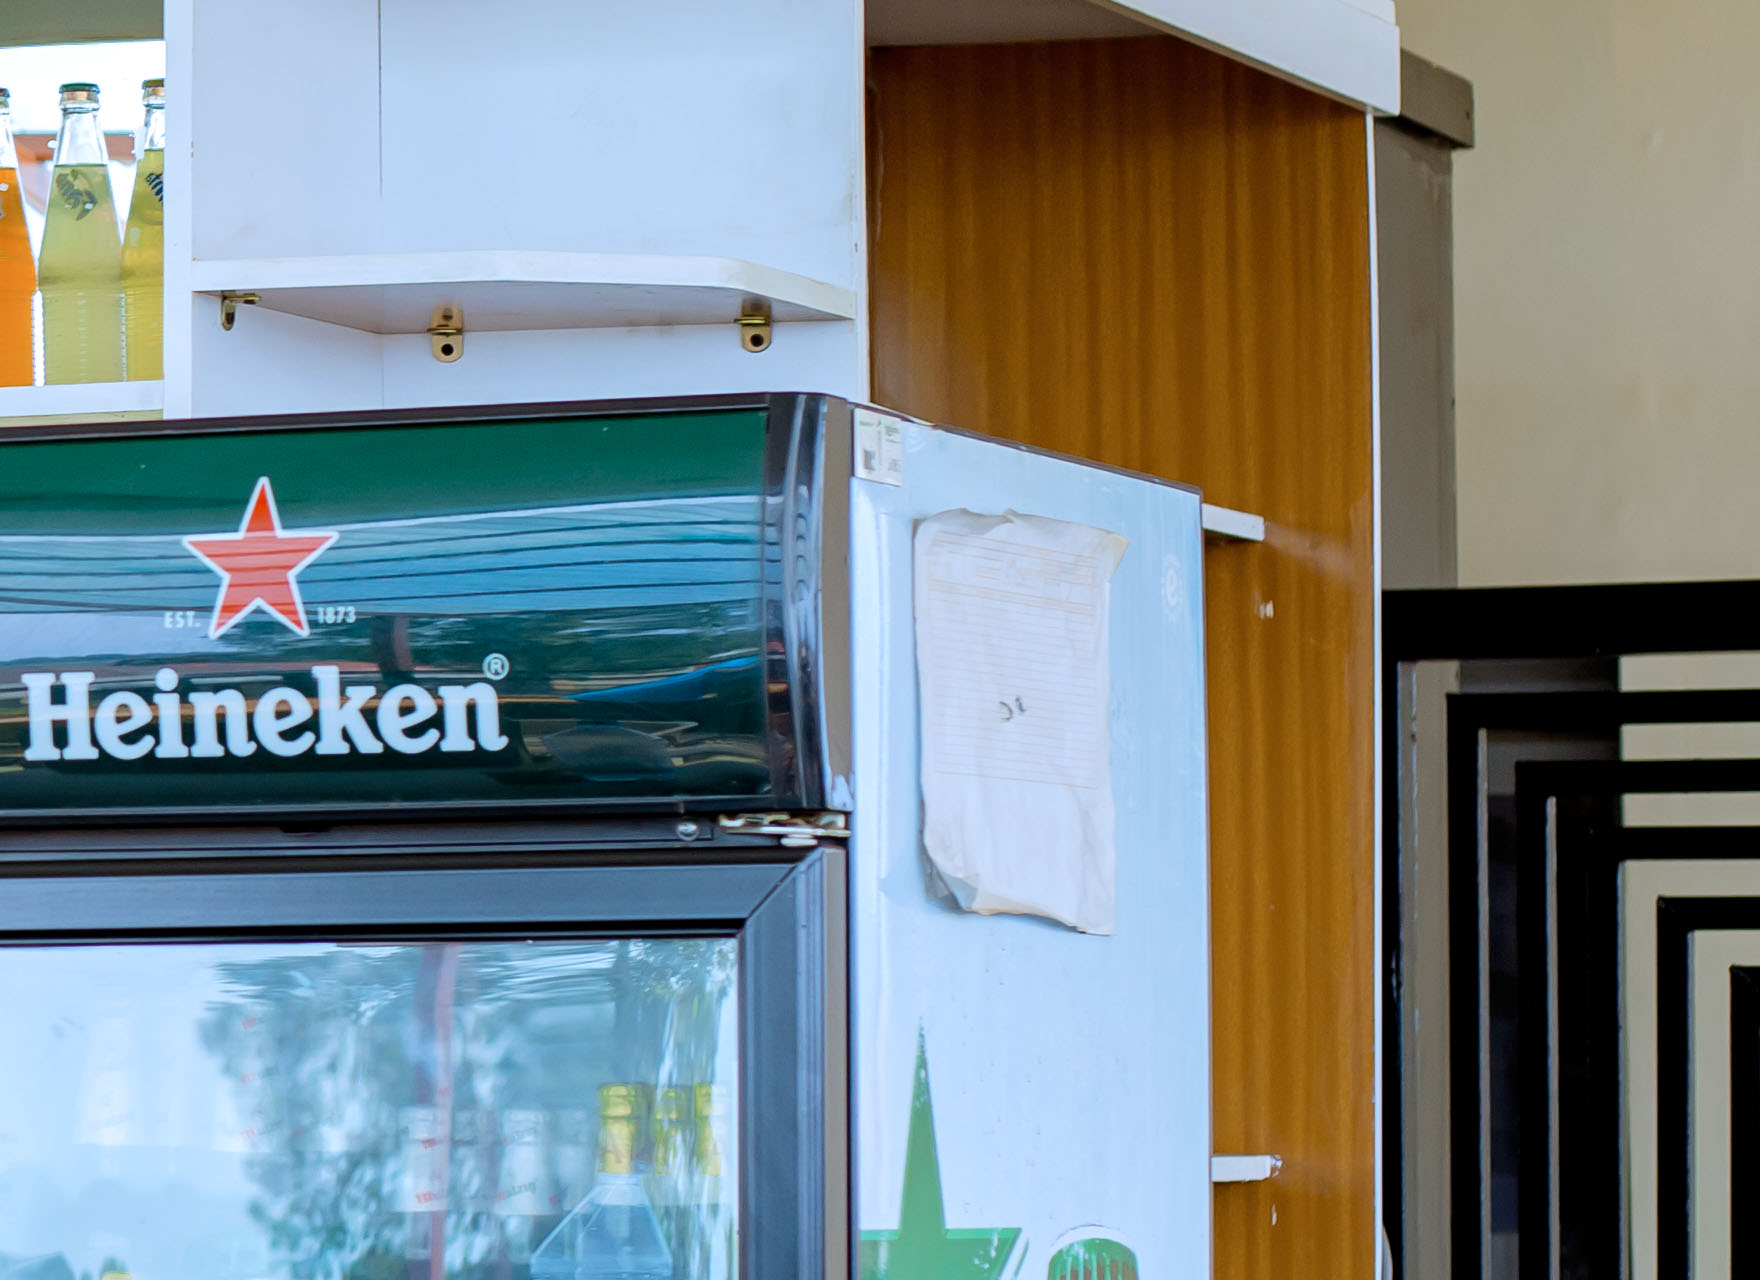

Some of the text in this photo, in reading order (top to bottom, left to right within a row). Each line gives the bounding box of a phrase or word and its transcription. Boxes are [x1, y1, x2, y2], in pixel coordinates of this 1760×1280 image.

[164, 606, 356, 629] EST. 1873
[21, 665, 510, 762] Heineken
